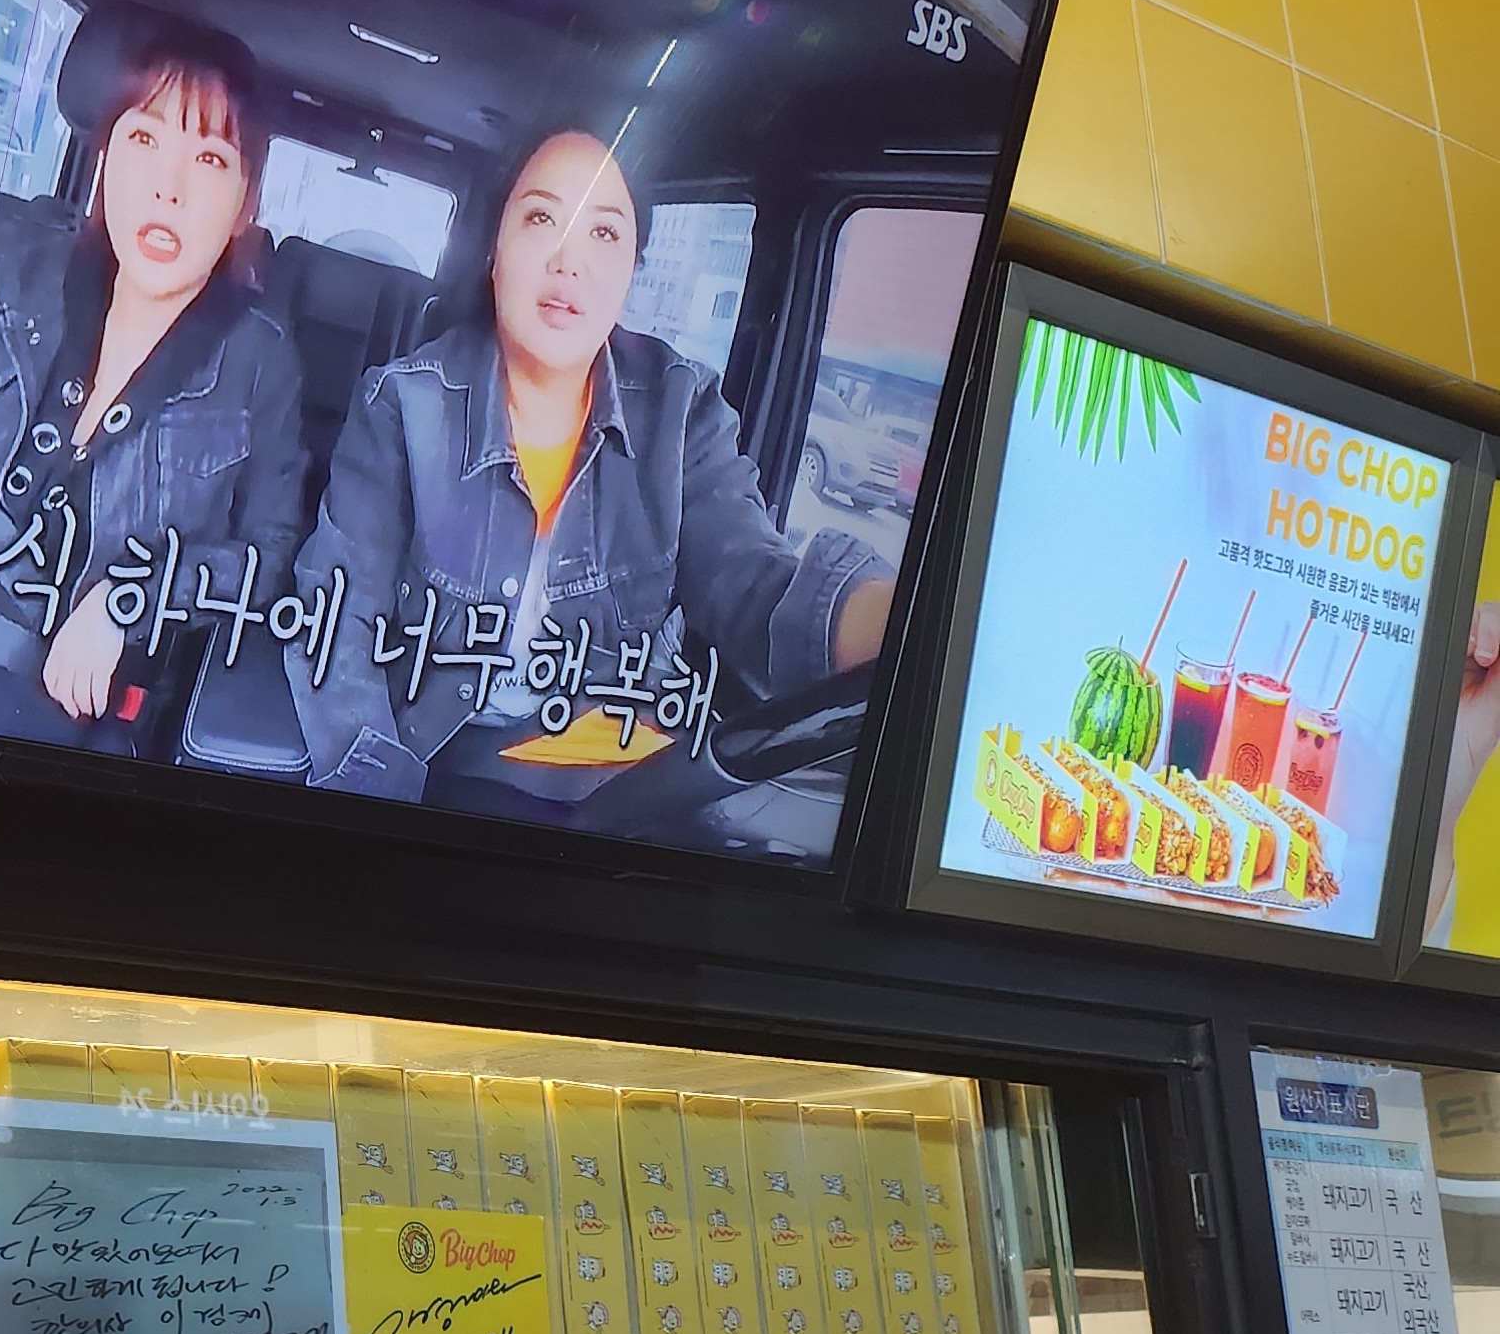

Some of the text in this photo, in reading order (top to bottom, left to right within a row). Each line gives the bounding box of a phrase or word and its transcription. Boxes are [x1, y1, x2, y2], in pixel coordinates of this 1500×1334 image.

[907, 0, 971, 61] SBS
[1265, 412, 1439, 510] BIG CHOP
[1266, 489, 1426, 580] HOTDOG
[1218, 539, 1251, 567] 고품격
[1253, 548, 1294, 579] 핫도그와
[1296, 562, 1326, 589] 시원한
[1328, 573, 1358, 599] 음료가
[1360, 582, 1380, 605] 있는
[104, 527, 347, 689] 하나에
[1310, 599, 1339, 625] 즐거운
[1341, 609, 1371, 635] 시간을
[1322, 1183, 1374, 1213] 돼지고기
[1330, 1237, 1381, 1266] 돼지고기
[1337, 1288, 1388, 1316] 돼지고기
[1403, 1309, 1440, 1334] 외국산
